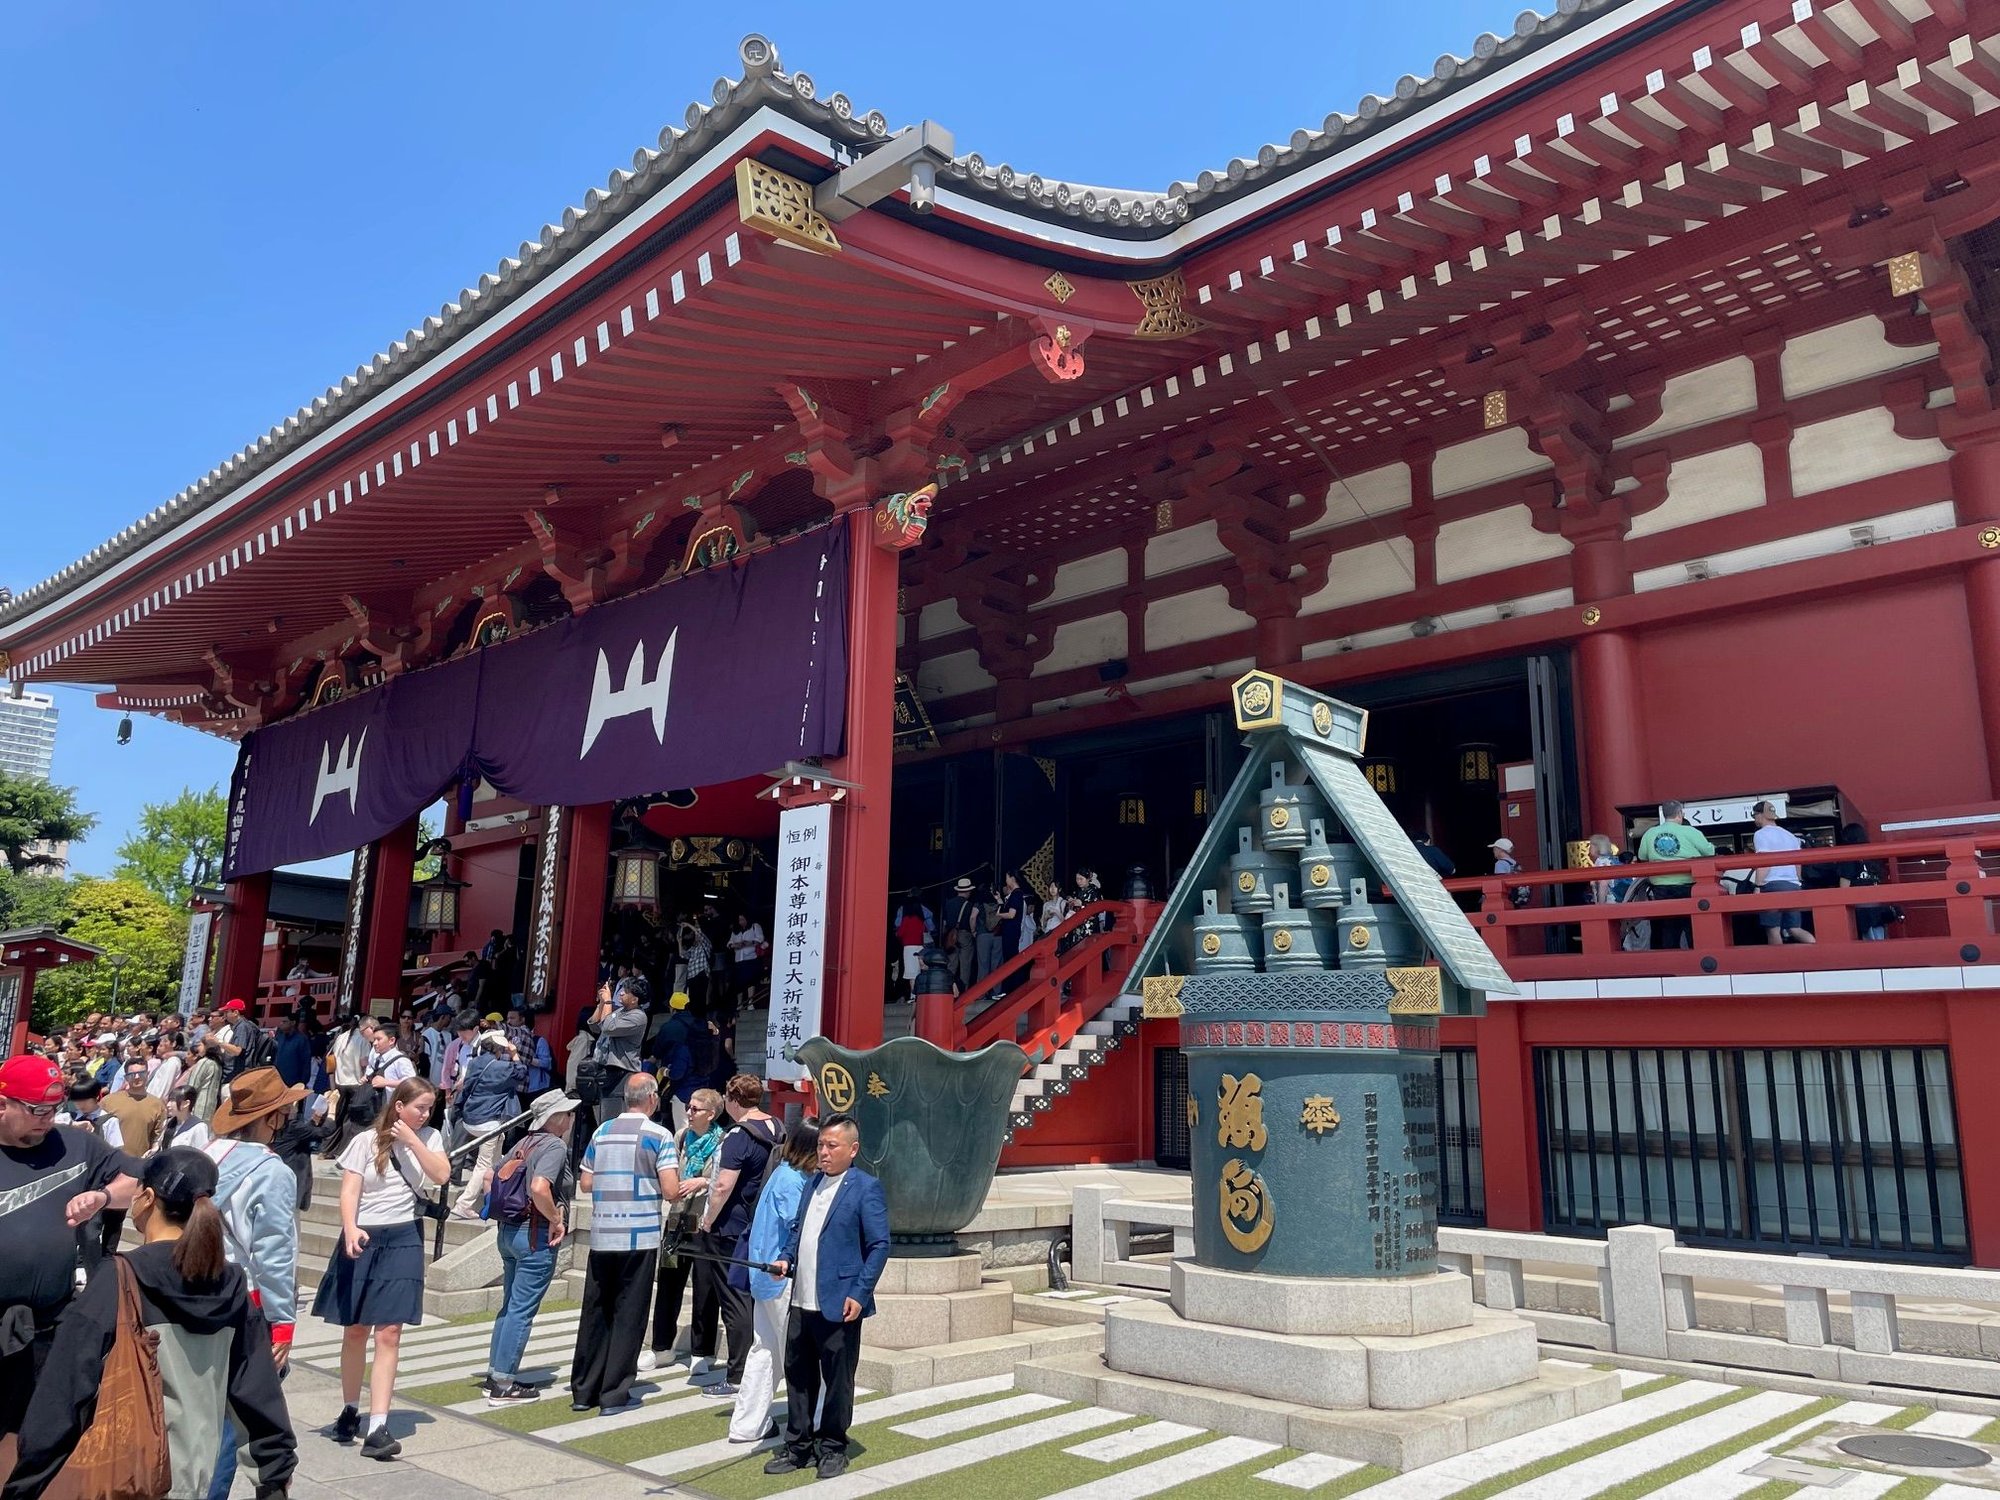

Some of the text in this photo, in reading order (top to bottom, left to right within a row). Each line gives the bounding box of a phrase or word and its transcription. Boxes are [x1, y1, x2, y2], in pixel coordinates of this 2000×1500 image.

[809, 861, 823, 987] 毎月十八日
[866, 1072, 890, 1099] 奉
[1301, 1093, 1341, 1135] 奉
